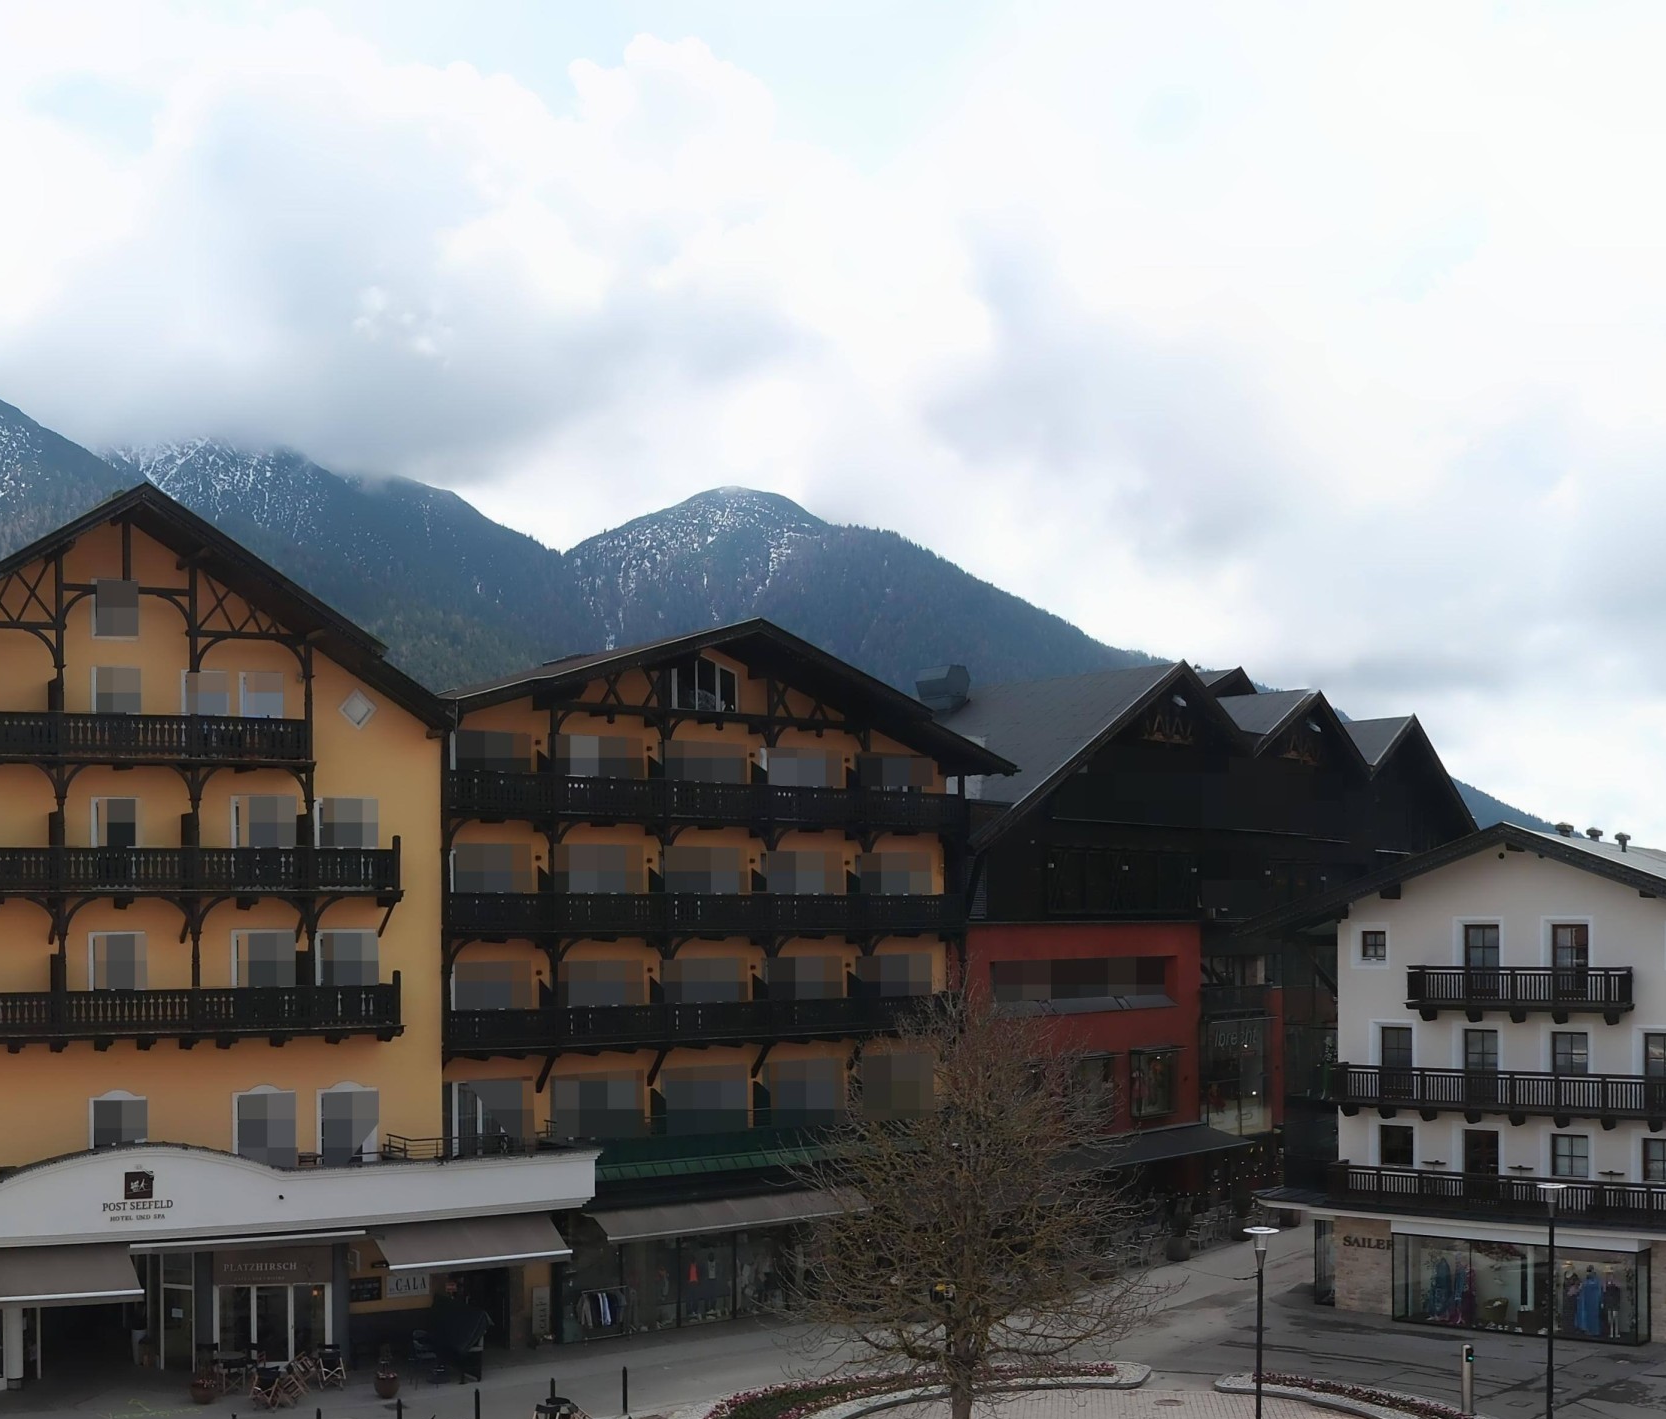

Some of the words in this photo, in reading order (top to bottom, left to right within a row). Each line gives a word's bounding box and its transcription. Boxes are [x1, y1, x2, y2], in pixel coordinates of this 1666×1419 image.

[102, 1202, 128, 1212] POST
[130, 1200, 173, 1211] SEEFELD
[223, 1261, 297, 1272] PLATZHIRSCH
